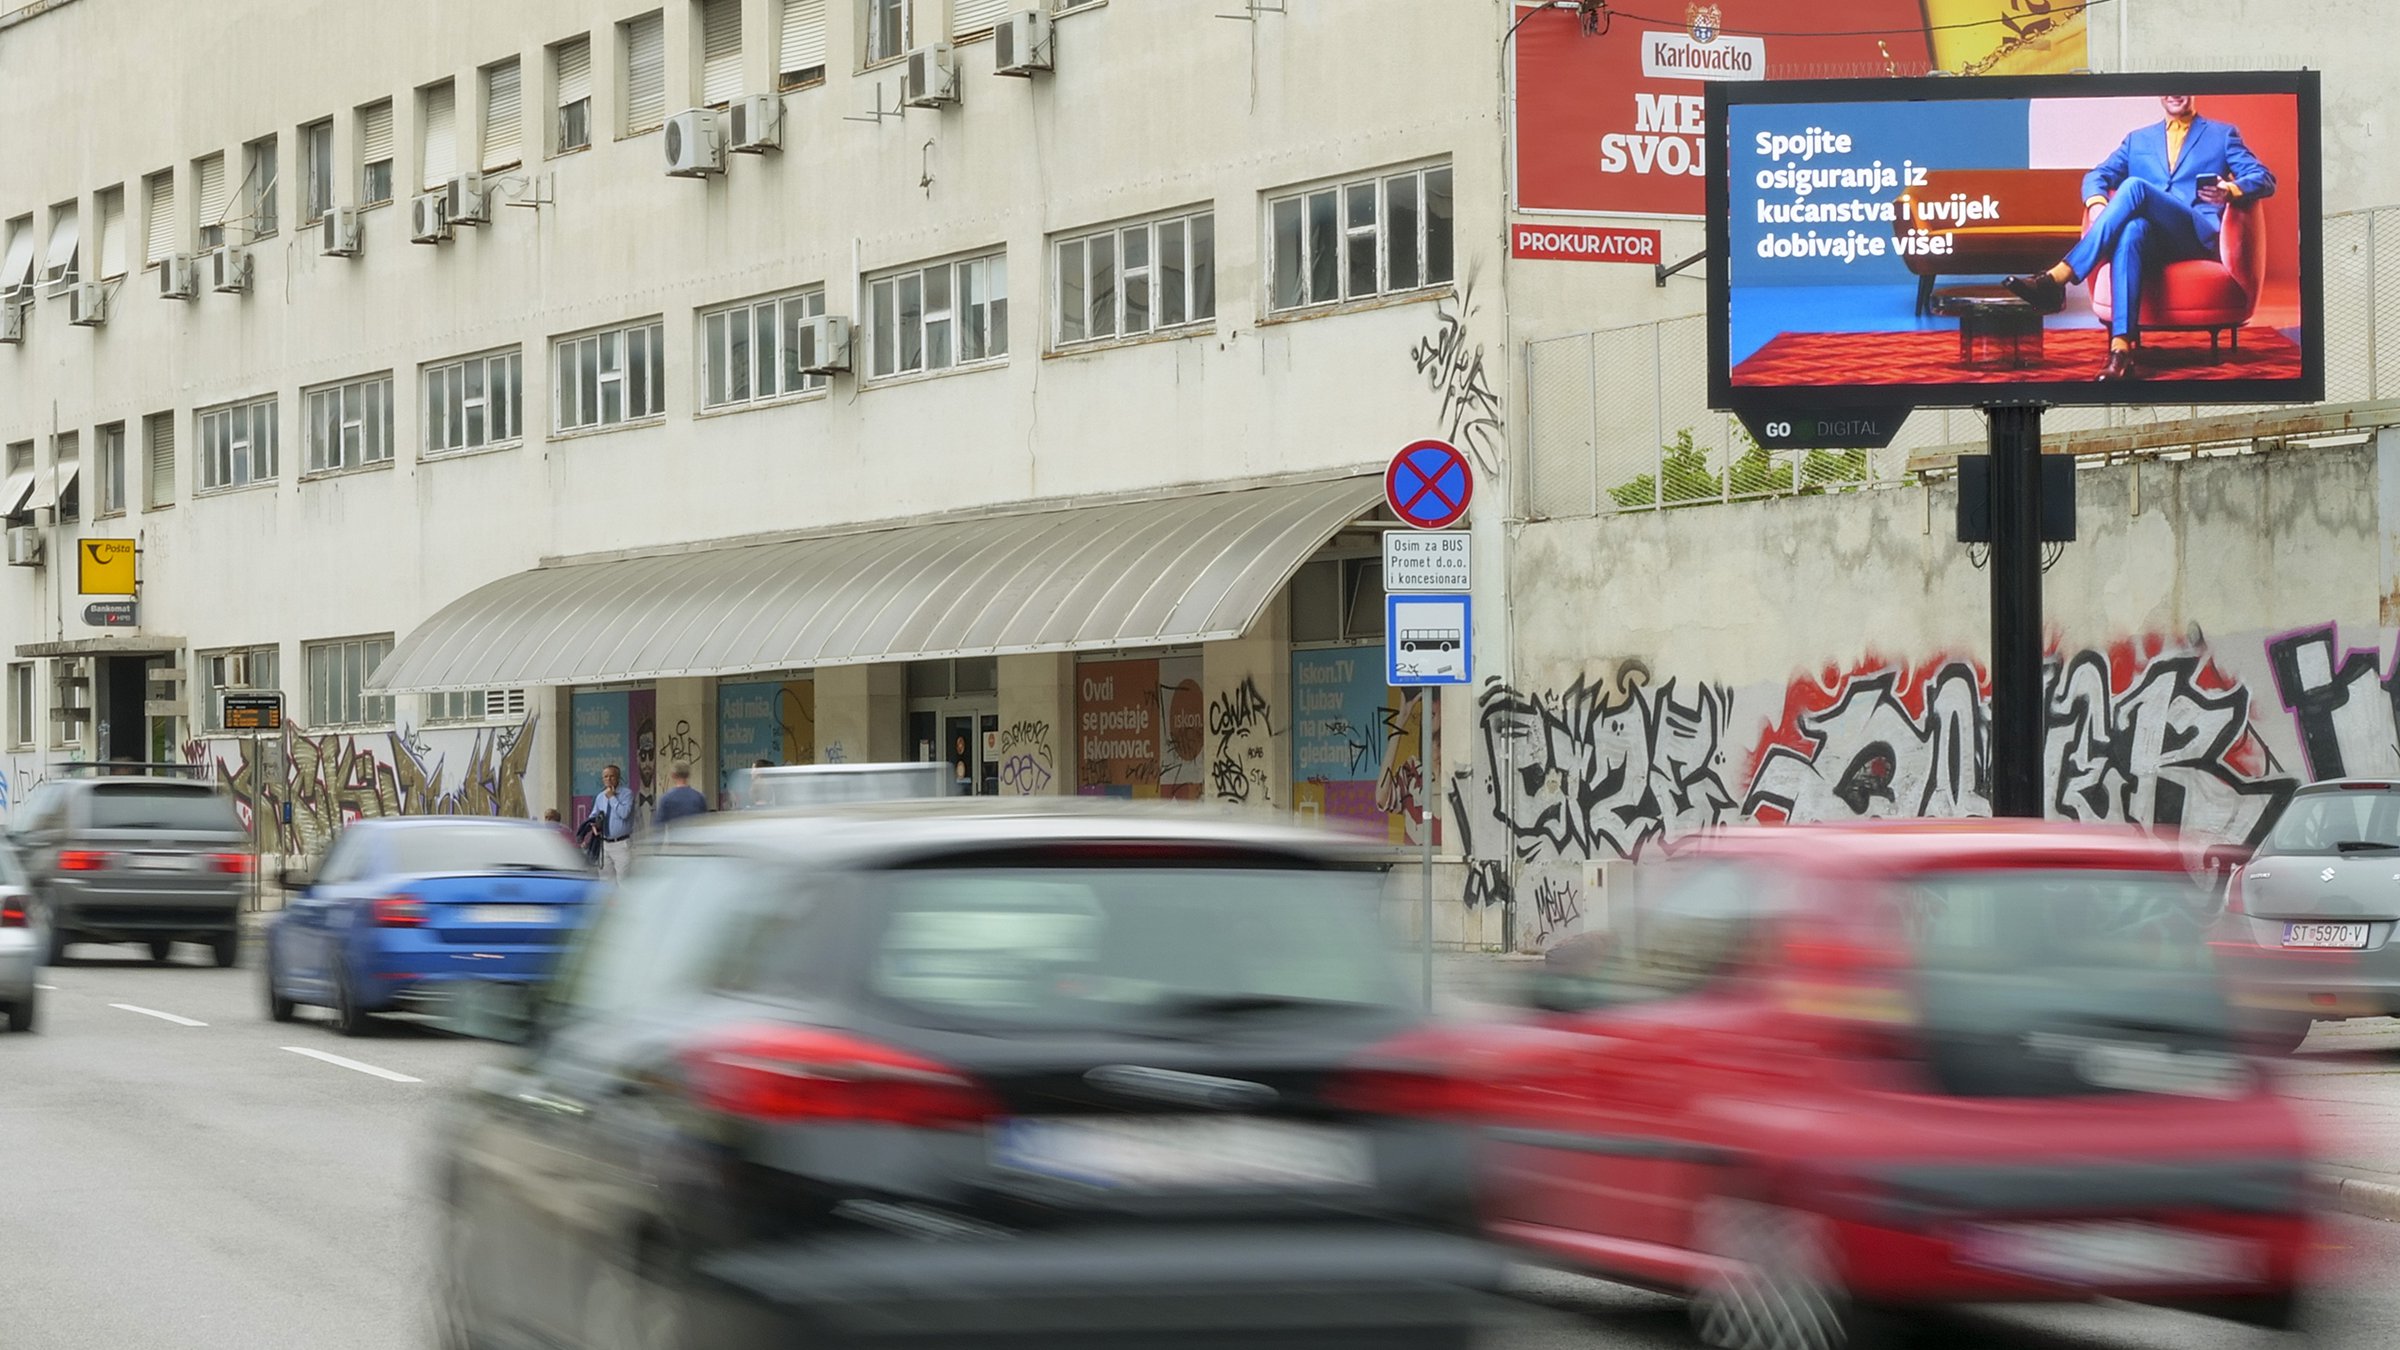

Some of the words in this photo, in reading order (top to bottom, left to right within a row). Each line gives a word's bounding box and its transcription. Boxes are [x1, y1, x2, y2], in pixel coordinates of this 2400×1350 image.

[1654, 42, 1752, 72] Karlovačko
[1755, 127, 1852, 162] Spojite
[1756, 160, 1898, 195] osiguranja
[1903, 160, 1928, 187] iz
[1757, 196, 1897, 223] kućanstva
[1903, 194, 1911, 221] i
[1918, 193, 2000, 227] uvijek
[1518, 232, 1654, 256] PROKURATOR
[1757, 230, 1886, 264] dobivajte
[1891, 229, 1954, 256] više!
[1765, 422, 1791, 437] GO
[1817, 420, 1881, 436] DIGITAL
[105, 544, 131, 553] Pošta
[1394, 539, 1420, 551] Osim
[1425, 542, 1437, 551] za
[1442, 539, 1463, 551] BUS
[1391, 556, 1431, 568] Promet
[1436, 556, 1467, 568] d.o.o.
[1390, 573, 1394, 584] i
[1398, 572, 1468, 584] koncesionara
[90, 604, 131, 613] Bankomat
[1299, 660, 1355, 684] Iskon.TV
[1082, 676, 1113, 702] Ovdi
[1300, 688, 1344, 715] Ljubav
[1082, 711, 1098, 731] se
[1100, 704, 1149, 735] postaje
[1083, 735, 1154, 760] Iskonovac.
[2291, 925, 2309, 941] ST
